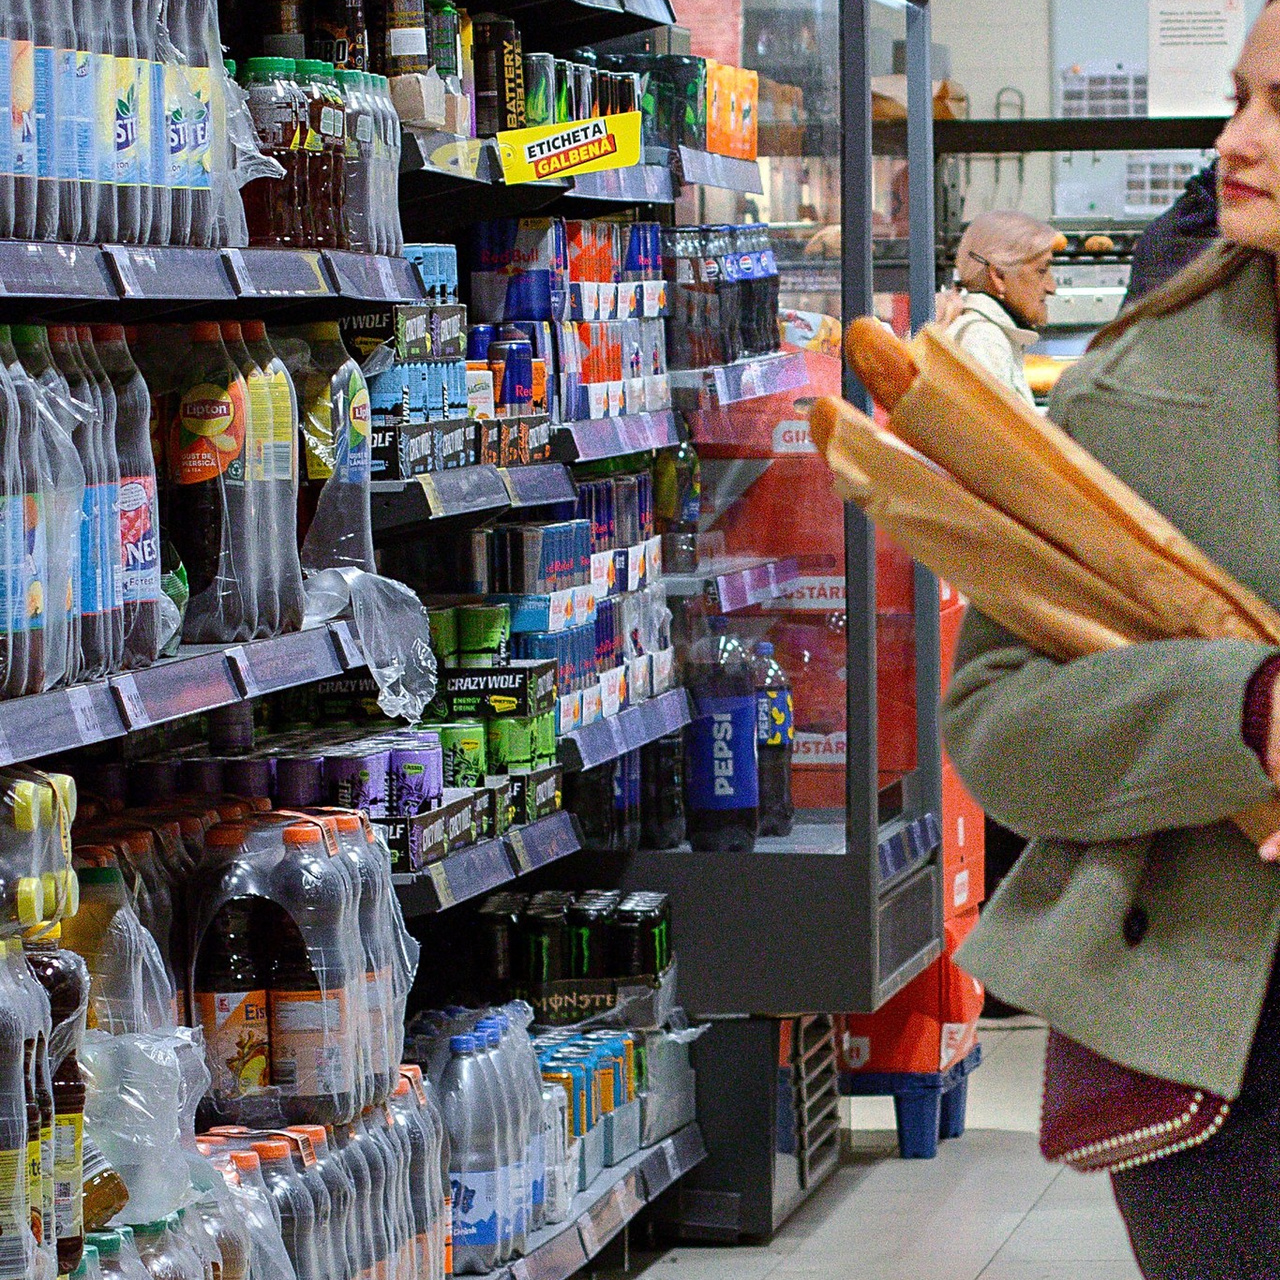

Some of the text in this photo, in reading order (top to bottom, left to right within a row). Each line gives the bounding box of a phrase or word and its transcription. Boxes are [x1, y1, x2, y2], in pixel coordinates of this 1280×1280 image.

[502, 40, 518, 129] BATTERY
[527, 123, 603, 159] ETICHETA
[480, 248, 539, 264] Red Bull
[350, 312, 391, 329] WOLF
[186, 403, 227, 418] Lipton
[371, 432, 394, 447] OLF
[126, 537, 156, 566] NES
[318, 680, 357, 694] CRAZY
[447, 674, 524, 691] CRAZY WOLF
[757, 698, 769, 739] PEPSI
[713, 713, 734, 796] PEPSI
[388, 824, 405, 840] LF
[532, 991, 617, 1012] MONSTE
[244, 1003, 265, 1021] Eis
